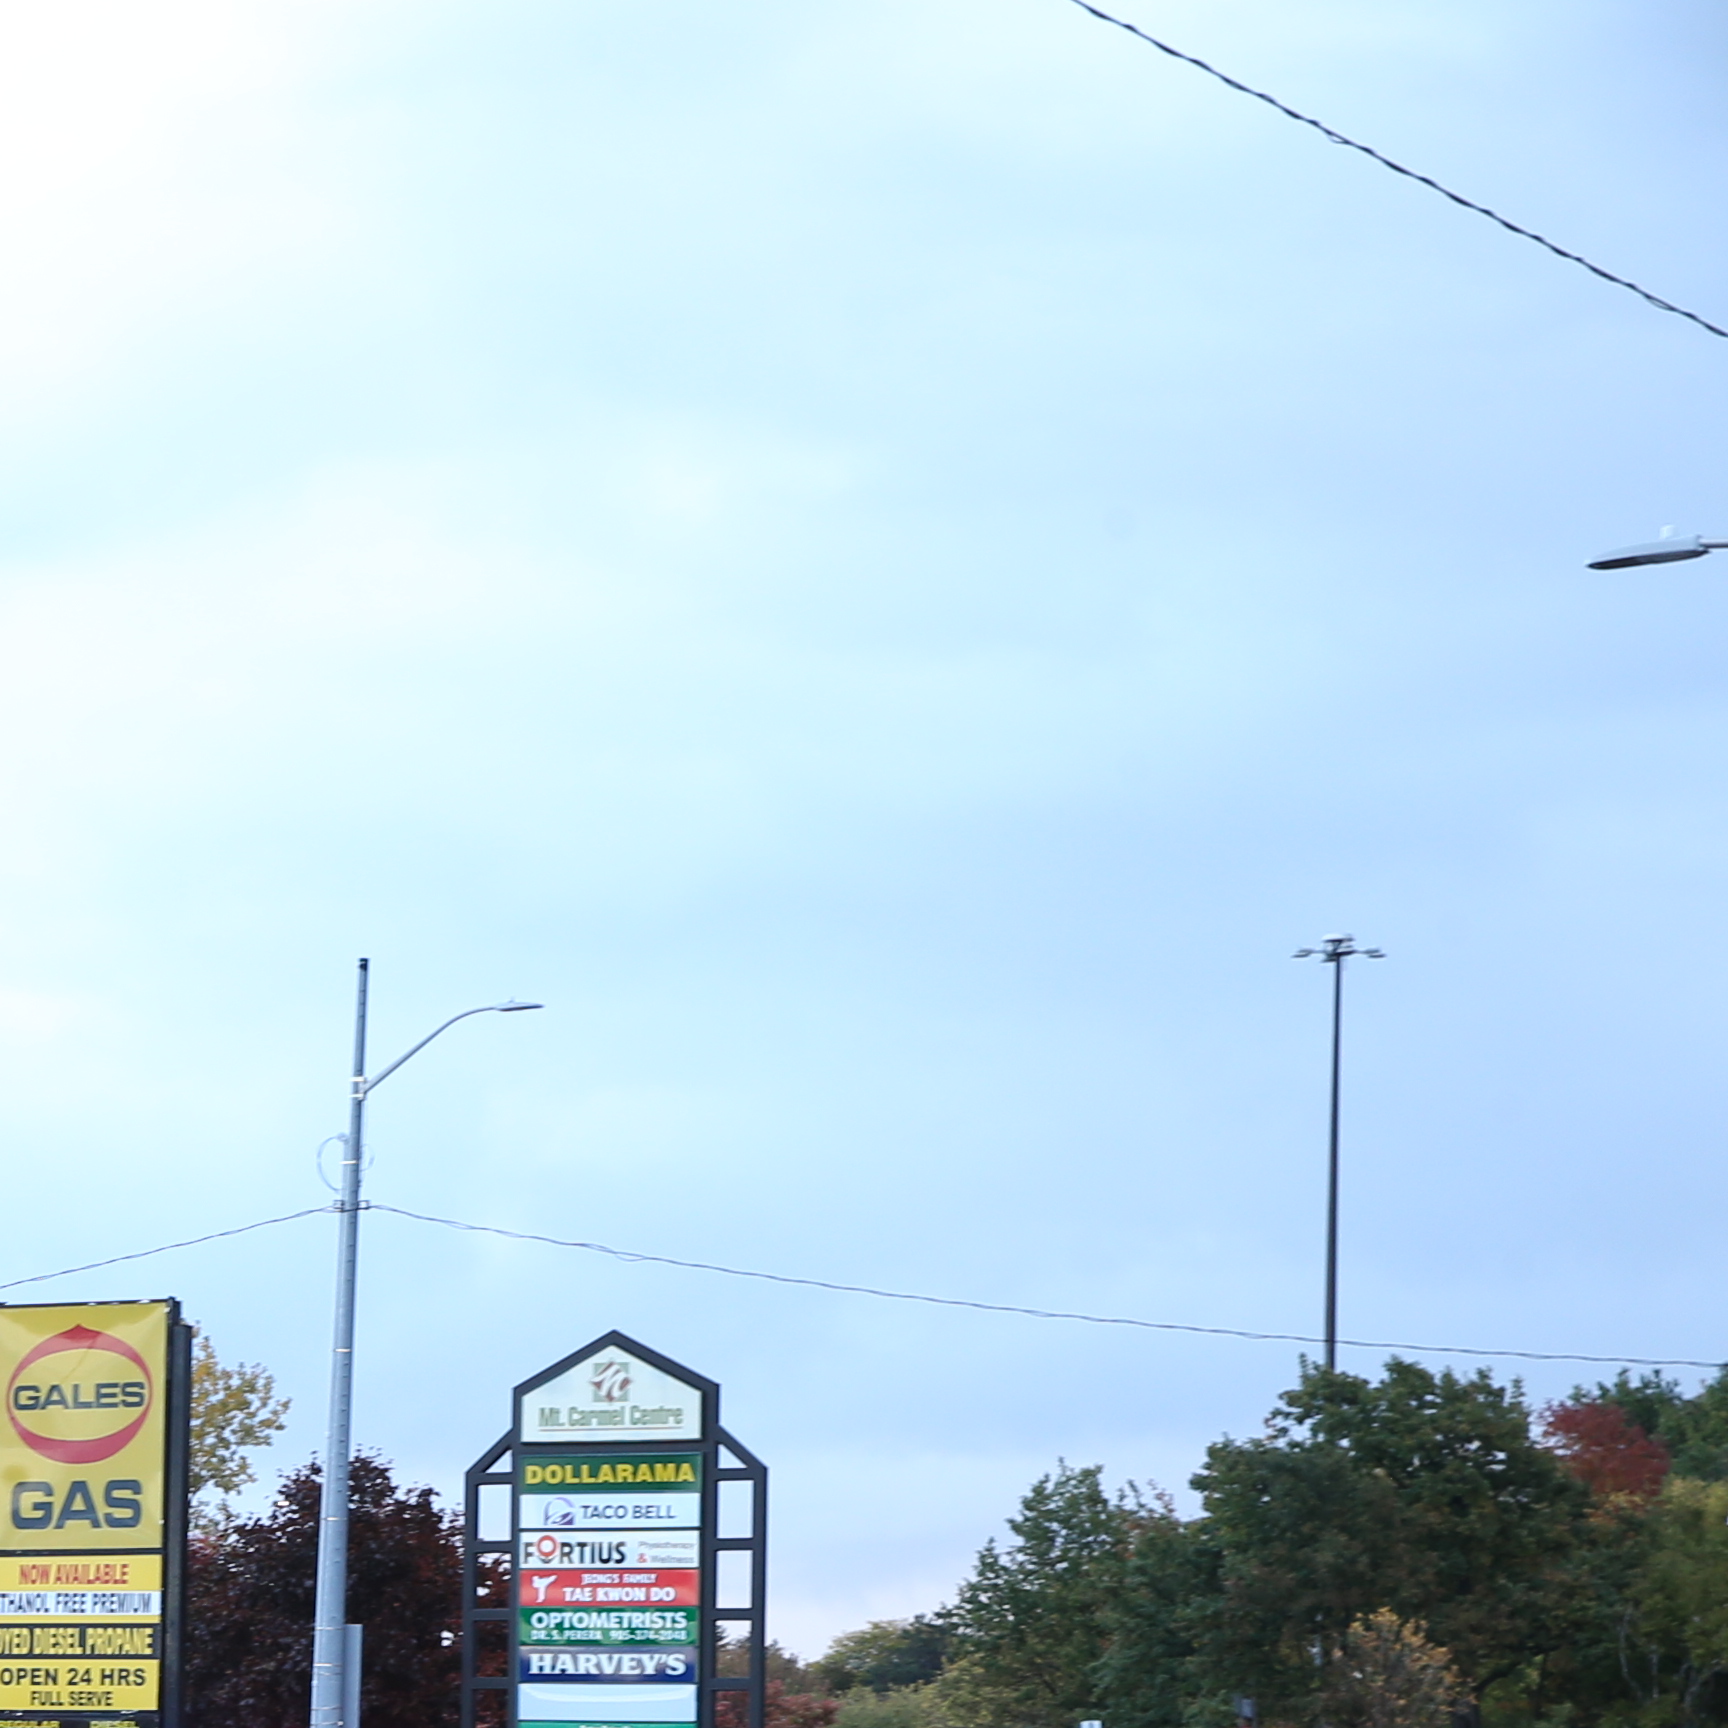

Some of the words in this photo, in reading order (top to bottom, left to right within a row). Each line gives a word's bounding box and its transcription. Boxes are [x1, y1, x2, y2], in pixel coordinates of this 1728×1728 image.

[13, 1382, 146, 1410] GALES
[568, 1406, 625, 1426] Carmel
[630, 1405, 683, 1425] Centre
[525, 1463, 696, 1484] DOLLARAMA
[11, 1479, 143, 1530] GAS
[580, 1505, 628, 1519] TACO
[632, 1504, 676, 1519] BELL
[522, 1536, 627, 1564] FORTIUS
[18, 1564, 52, 1585] NOW
[54, 1564, 130, 1585] AVAILABLE
[56, 1592, 86, 1613] FREE
[91, 1592, 152, 1613] PREMIUM
[563, 1587, 592, 1601] TAE
[596, 1587, 646, 1601] KWON
[650, 1586, 676, 1601] DO
[530, 1611, 687, 1628] OPTOMETRISTS
[33, 1627, 83, 1655] DIESEL
[85, 1627, 153, 1655] PROPANE
[528, 1653, 687, 1675] HARVEY'S
[0, 1668, 58, 1686] OPEN
[66, 1668, 92, 1686] 24
[100, 1668, 146, 1686] HRS
[30, 1691, 64, 1706] FULL
[68, 1691, 114, 1706] SERVE
